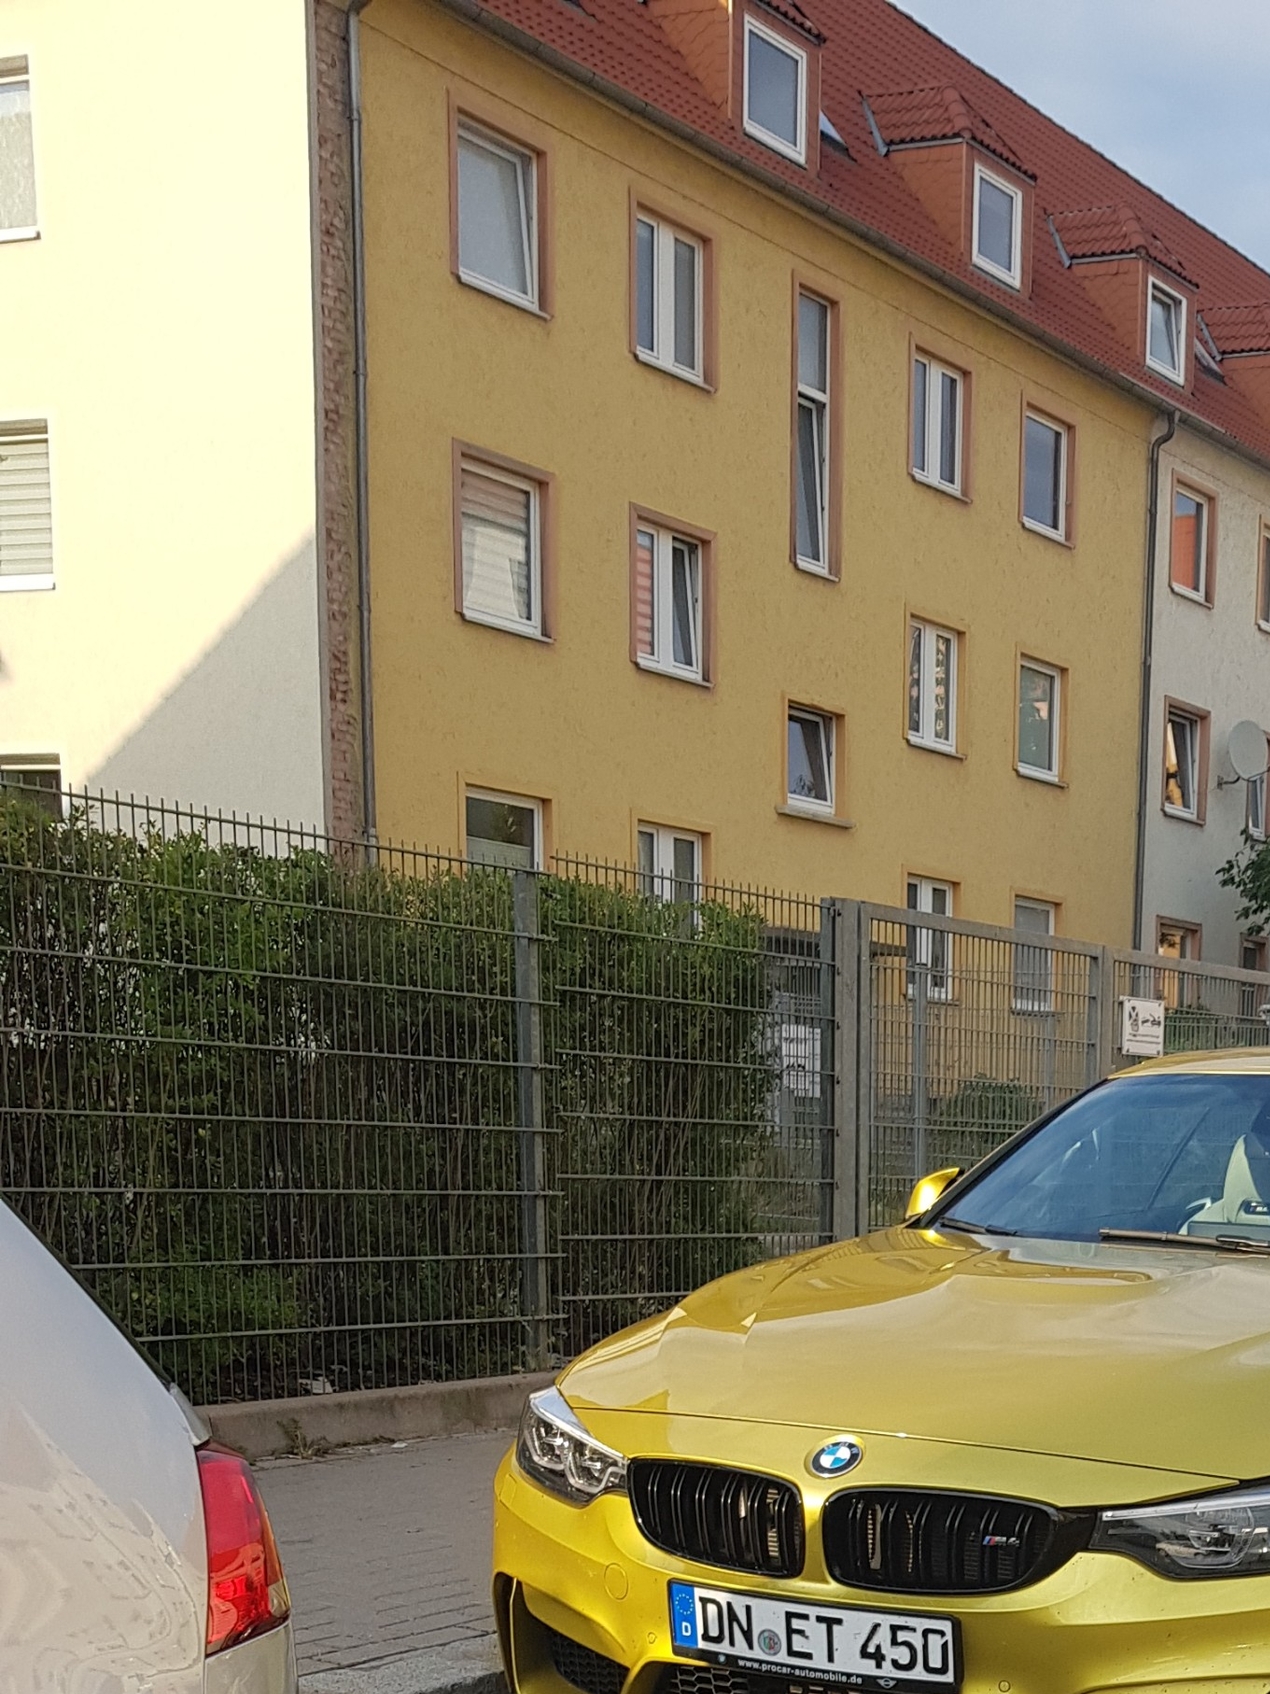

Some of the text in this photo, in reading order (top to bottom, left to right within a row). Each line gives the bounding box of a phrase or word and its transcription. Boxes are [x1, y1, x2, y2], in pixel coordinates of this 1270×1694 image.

[682, 1621, 692, 1636] D
[698, 1596, 949, 1675] DN ET 450
[738, 1659, 863, 1684] www.procar-automobile.de
